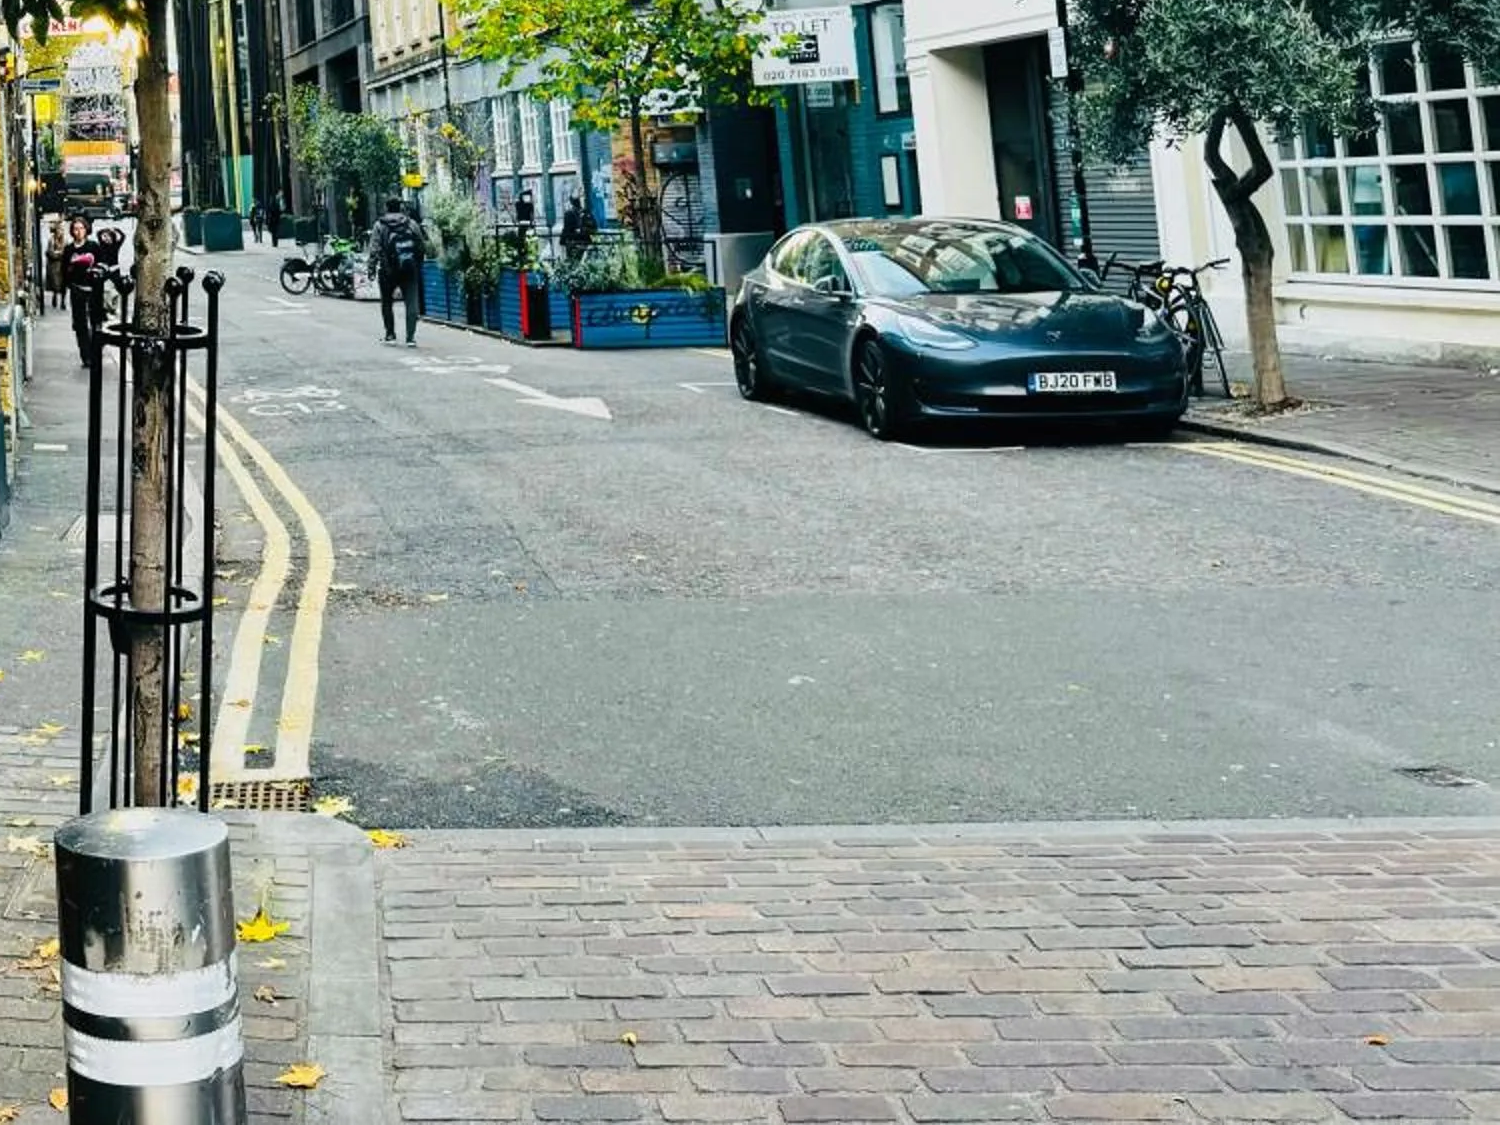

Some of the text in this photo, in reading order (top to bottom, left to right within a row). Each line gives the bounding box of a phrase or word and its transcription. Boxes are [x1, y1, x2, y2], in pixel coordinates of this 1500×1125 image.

[773, 19, 830, 34] TO LET
[763, 69, 785, 81] 020
[1040, 374, 1079, 388] BJ20
